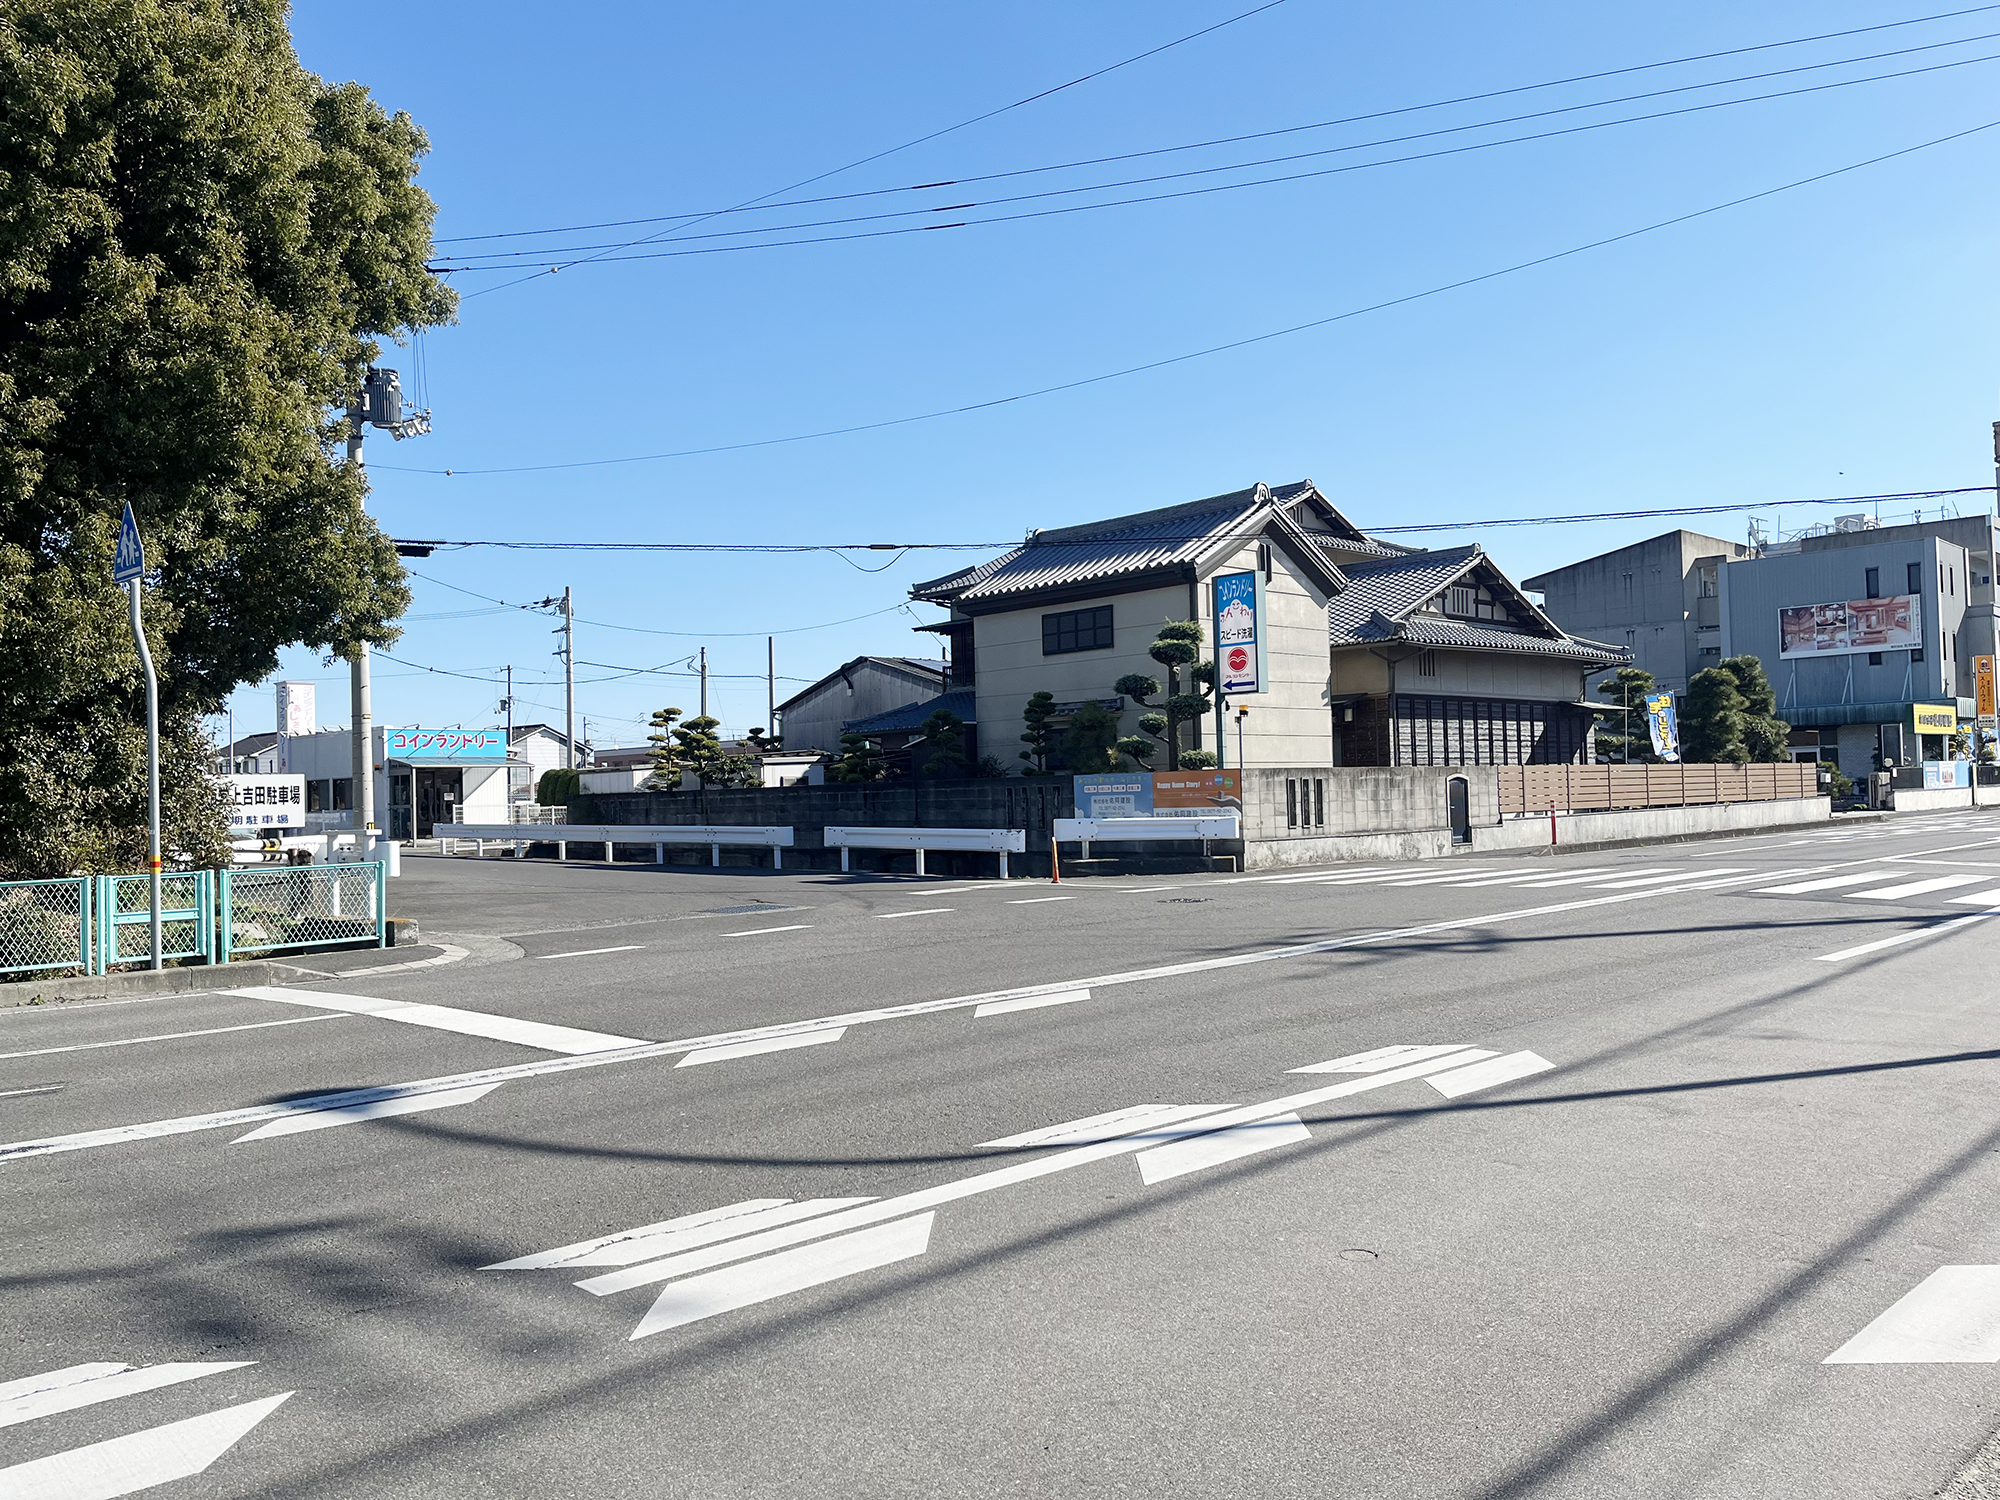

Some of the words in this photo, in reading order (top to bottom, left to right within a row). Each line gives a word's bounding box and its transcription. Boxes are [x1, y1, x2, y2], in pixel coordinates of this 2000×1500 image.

[1220, 627, 1253, 641] スピード洗濯
[394, 733, 499, 749] コインランドリー
